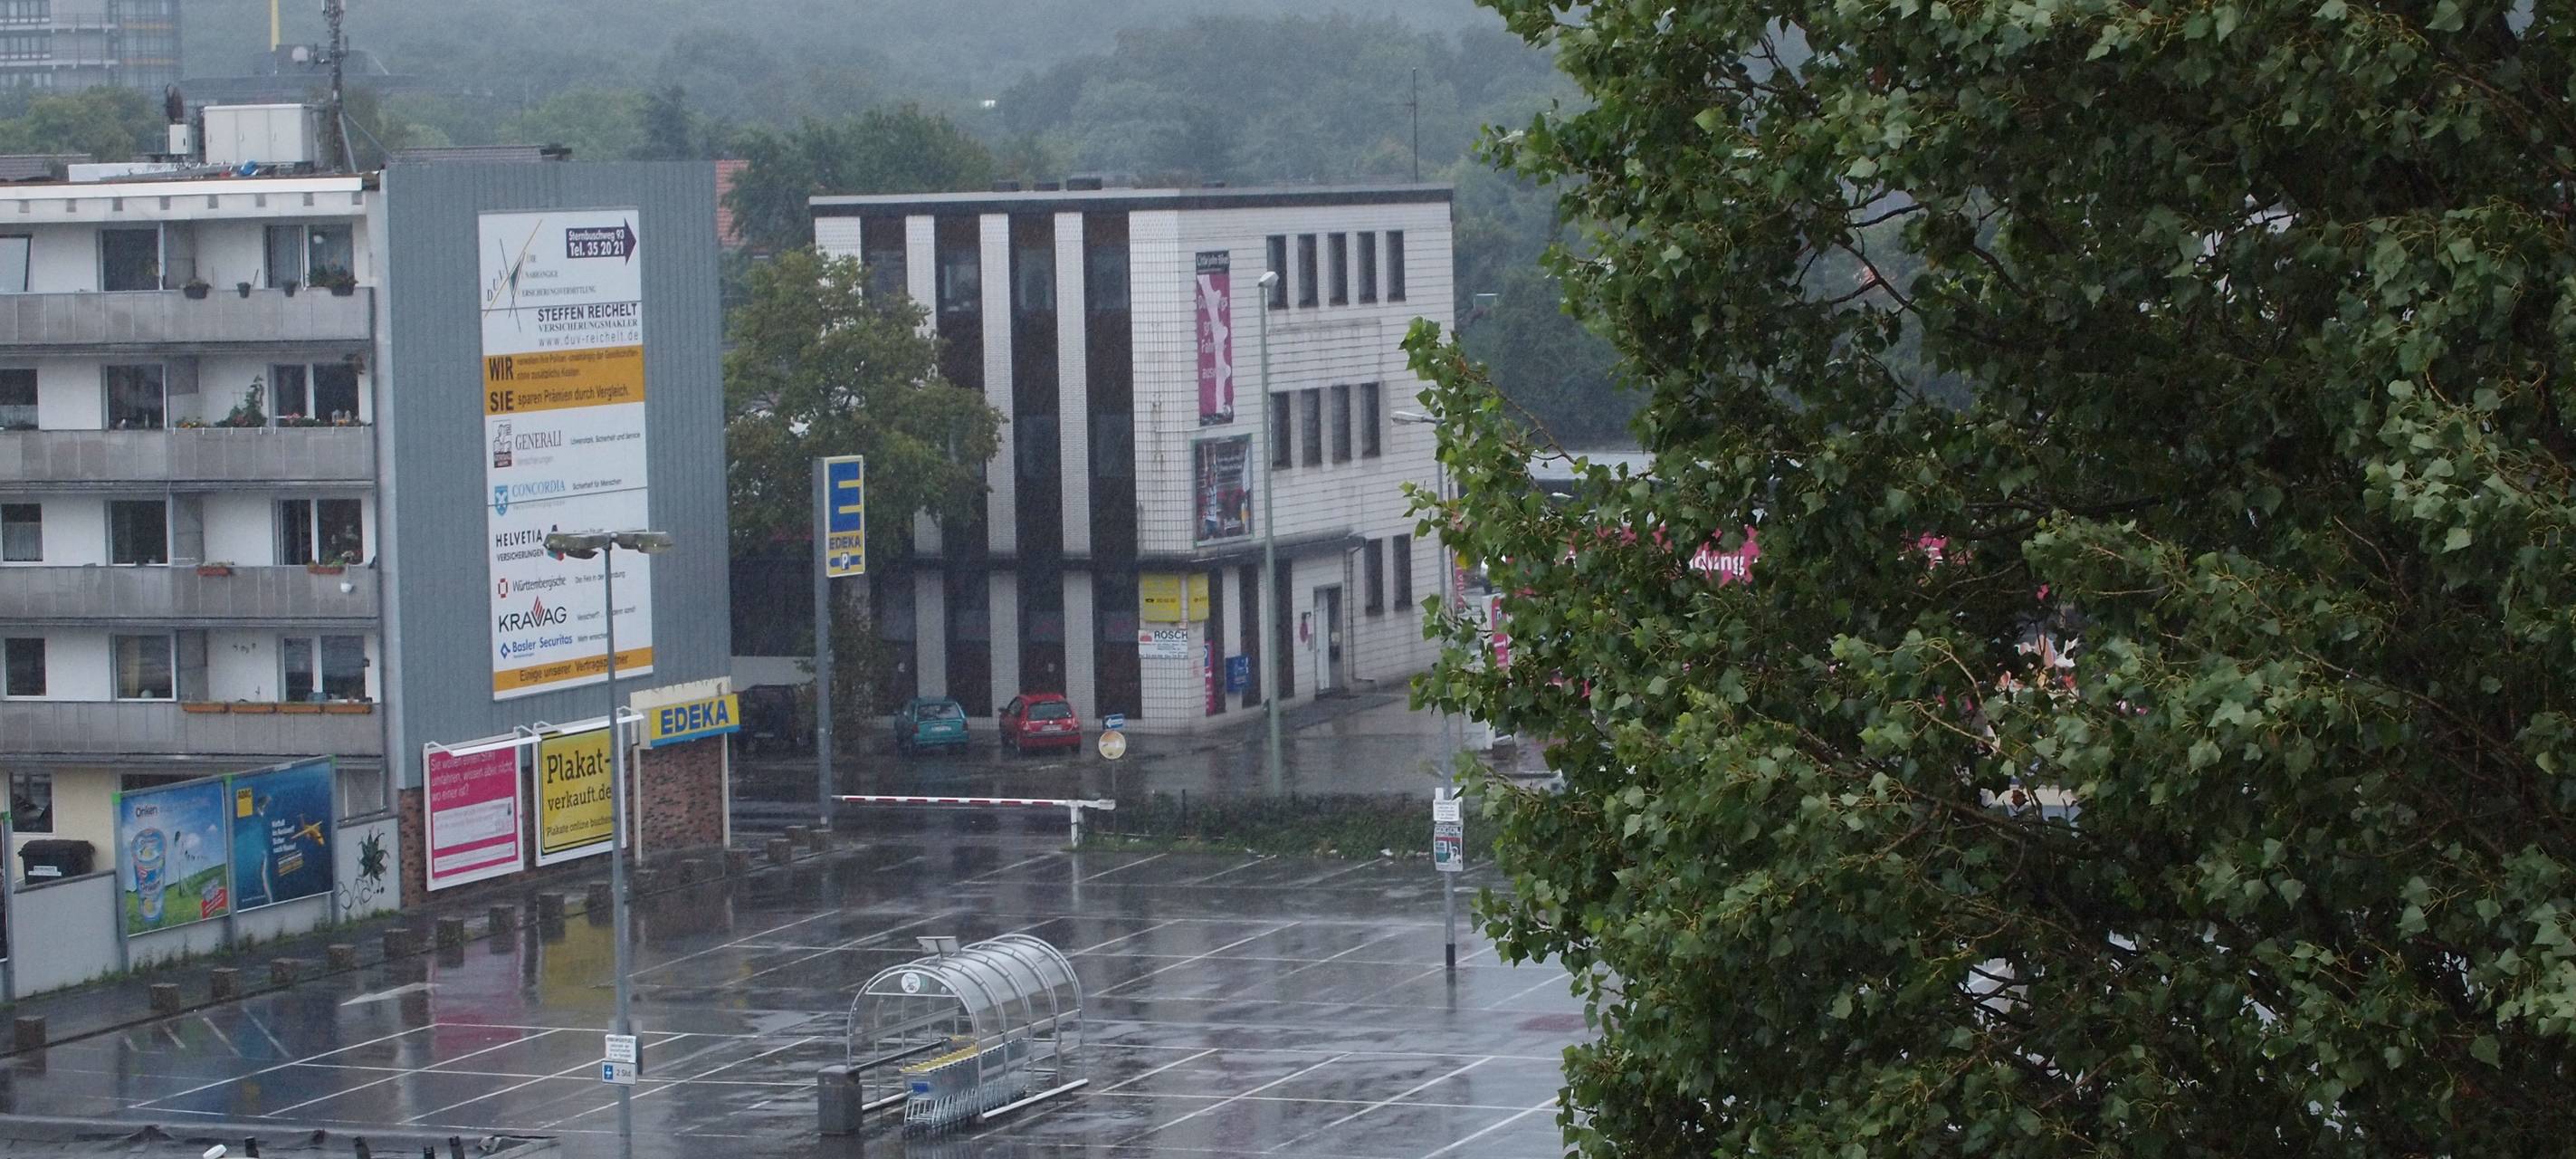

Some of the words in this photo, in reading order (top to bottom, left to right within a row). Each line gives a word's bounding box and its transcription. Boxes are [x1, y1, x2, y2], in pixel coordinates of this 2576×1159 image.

[568, 229, 615, 242] Sternbuschweg
[615, 229, 625, 239] 93
[569, 241, 586, 256] Tel.
[587, 241, 598, 255] 35
[600, 241, 612, 255] 20
[613, 240, 625, 255] 21
[538, 307, 585, 322] STEFFEN
[588, 303, 638, 319] REICHELT
[538, 319, 638, 333] VERSICHERUNGSMAKLER
[538, 330, 639, 347] www.duv-reichelt.de
[489, 356, 514, 381] WIR
[491, 390, 515, 412] SIE
[518, 393, 542, 407] sparen
[544, 388, 573, 402] Prämien
[574, 386, 595, 400] durch
[515, 429, 562, 451] GENERALI
[511, 479, 566, 497] CONCORDIA
[496, 529, 543, 548] HELVETIA
[829, 535, 861, 551] EDEKA
[497, 548, 544, 562] VERSICHERUNGEN
[512, 575, 567, 591] Württembergische
[499, 606, 567, 634] KRAVAG
[512, 639, 537, 653] Basler
[539, 634, 573, 649] Securitas
[520, 667, 543, 682] Einige
[544, 664, 571, 678] unserer
[661, 700, 730, 735] EDEKA
[547, 748, 611, 784] Plakat-
[548, 783, 612, 811] verkauft.de
[136, 804, 158, 818] Onken
